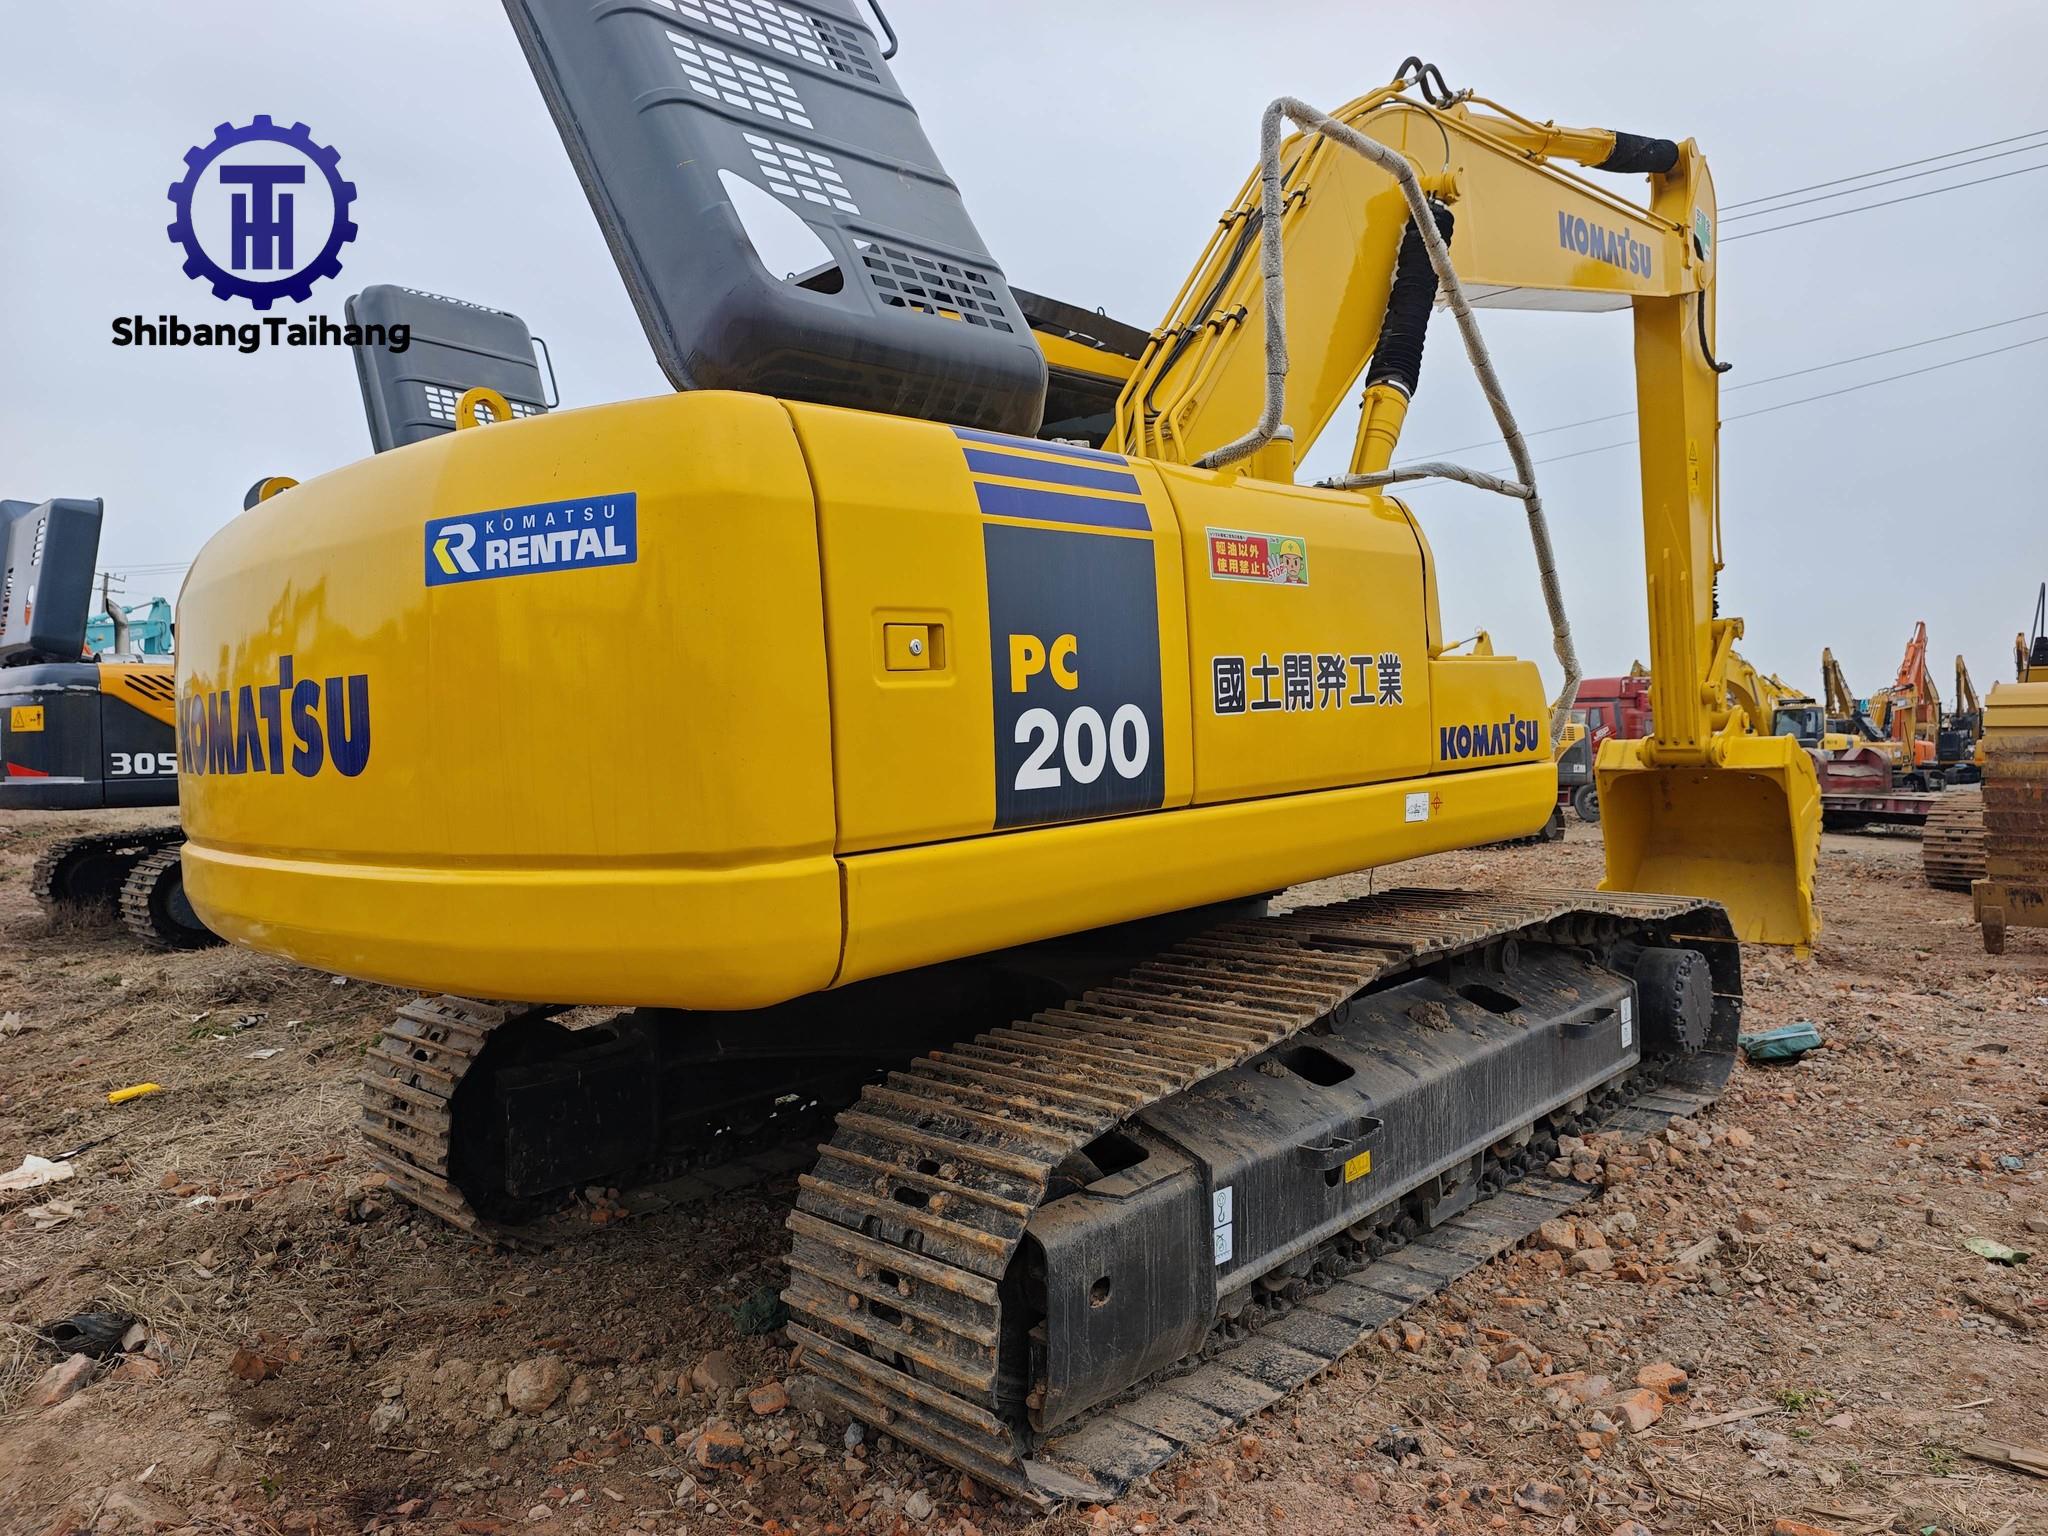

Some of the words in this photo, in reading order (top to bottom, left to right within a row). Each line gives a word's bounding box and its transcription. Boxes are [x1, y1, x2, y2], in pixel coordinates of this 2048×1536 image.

[1559, 211, 1652, 279] KOMATSU
[485, 504, 615, 534] KOMATSU
[485, 525, 627, 571] RENTAL
[1009, 633, 1079, 692] PC
[1213, 652, 1403, 714] 國土開発工業
[178, 655, 371, 777] KOMATSU
[1440, 713, 1538, 761] KOMATSU
[110, 752, 178, 775] 305
[1014, 703, 1150, 791] 200
